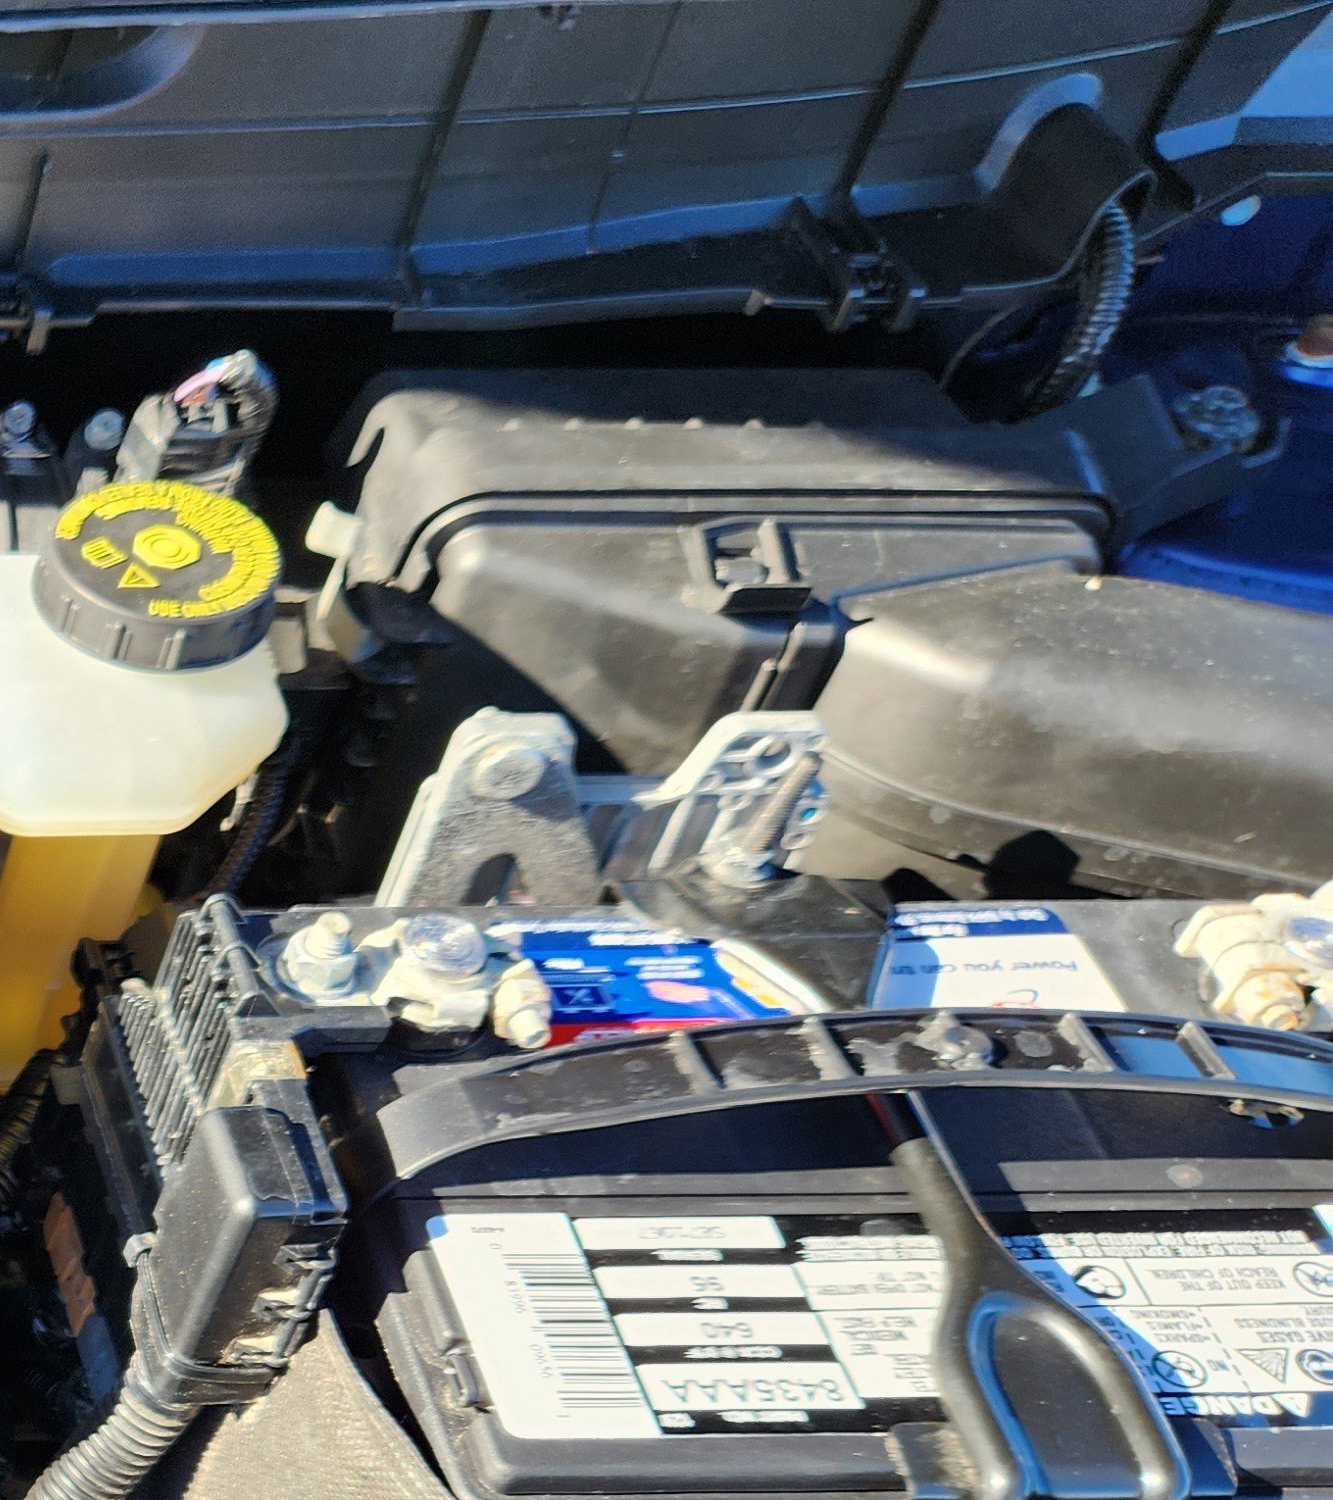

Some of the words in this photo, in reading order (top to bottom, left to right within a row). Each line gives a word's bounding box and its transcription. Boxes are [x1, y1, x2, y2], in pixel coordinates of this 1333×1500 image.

[964, 959, 1005, 973] you
[1010, 960, 1078, 973] Power
[699, 1322, 753, 1340] 640
[660, 1378, 843, 1403] 8435AAA
[1157, 1395, 1283, 1417] DANGE
